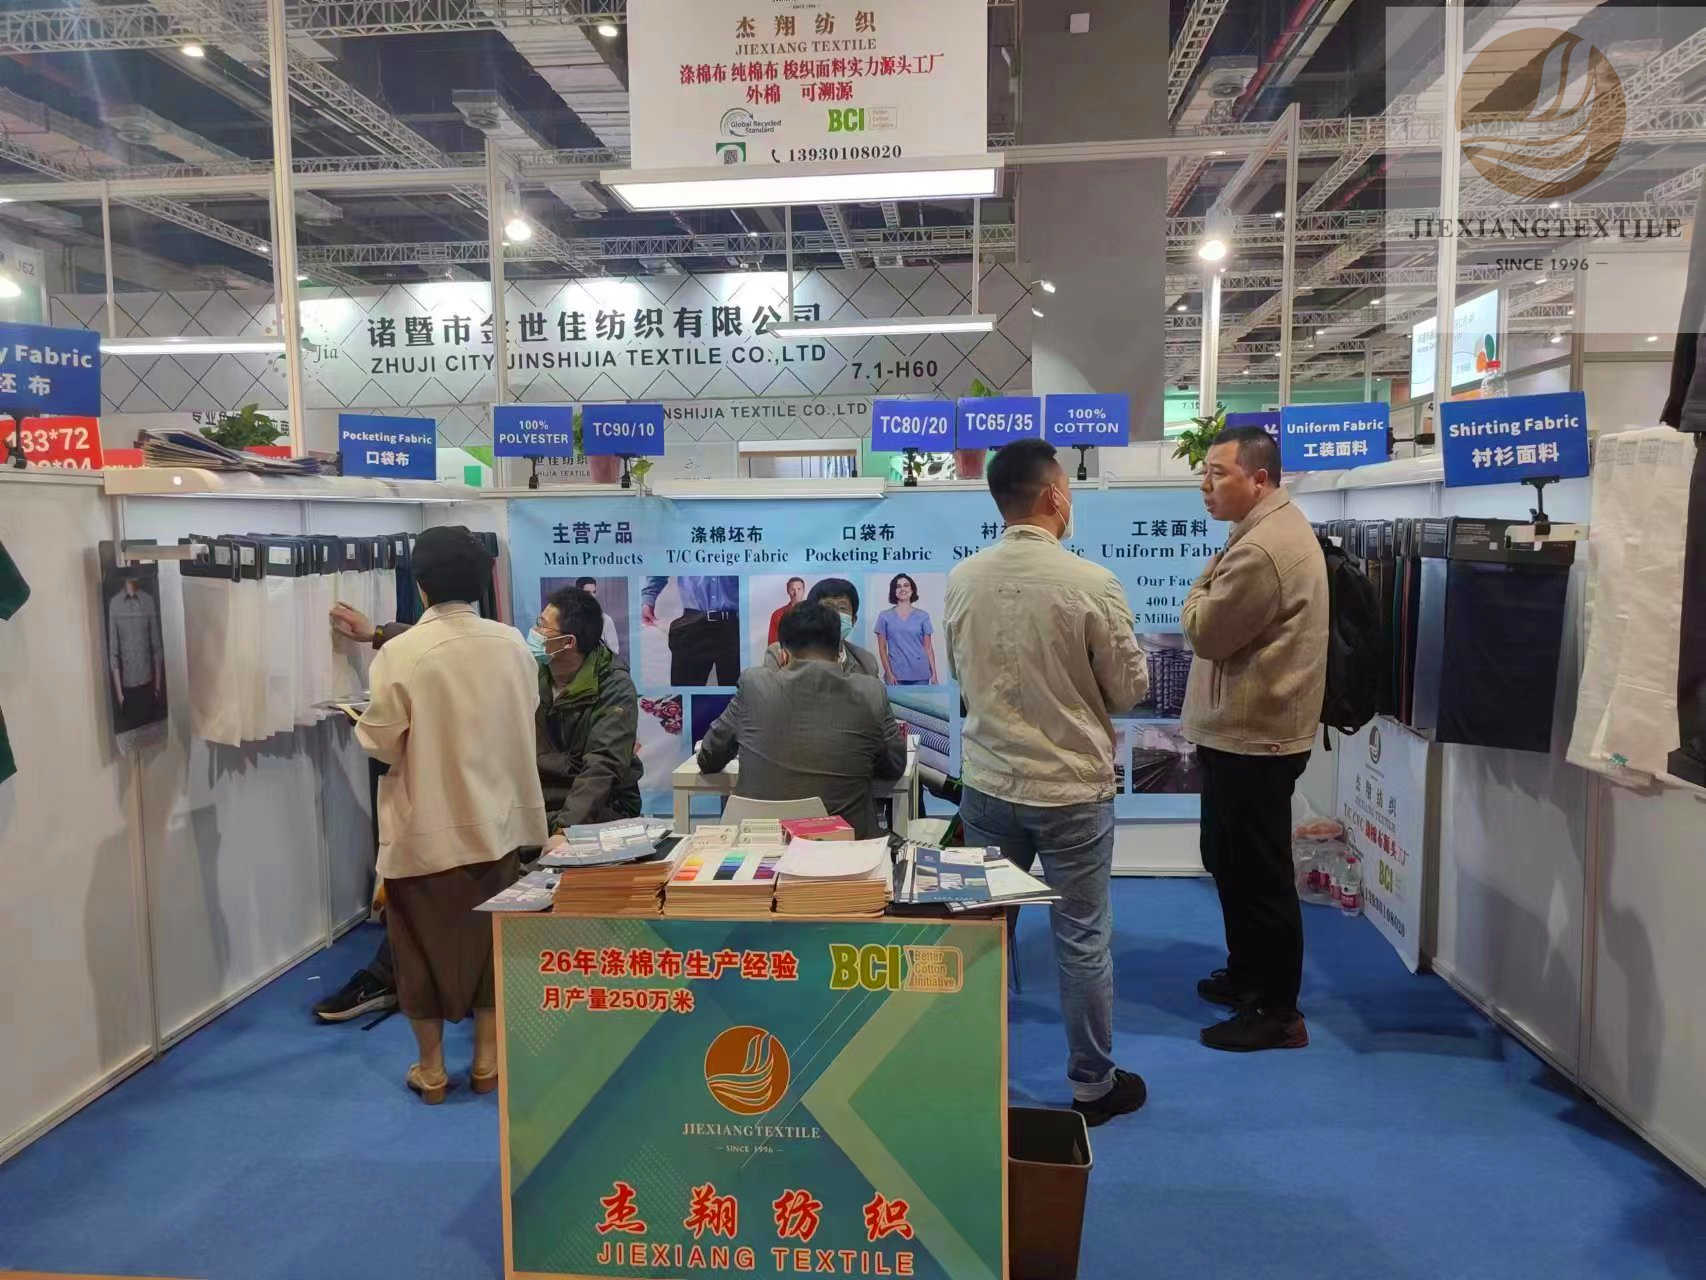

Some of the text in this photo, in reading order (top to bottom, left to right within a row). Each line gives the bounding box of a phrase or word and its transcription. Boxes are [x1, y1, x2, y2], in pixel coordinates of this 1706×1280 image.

[736, 10, 876, 39] 杰翔纺织
[736, 38, 877, 55] JIEXIANG TEXTILE
[680, 63, 727, 84] 涤棉布
[731, 60, 778, 81] 纯棉布
[731, 119, 782, 129] Global Recycled
[828, 108, 865, 133] BCI
[789, 145, 902, 162] 13930108020
[15, 344, 93, 369] Fabric
[371, 356, 436, 374] ZHUJI
[445, 353, 495, 372] CITY
[507, 350, 617, 370] JINSHIJIA
[626, 347, 721, 366] TEXTILE
[852, 360, 938, 380] 7.1-H60
[731, 403, 797, 419] TEXTILE
[1067, 408, 1107, 420] 100%
[519, 420, 549, 431] 100%
[593, 421, 655, 438] TC90/10
[880, 415, 948, 435] TC80/20
[965, 412, 1034, 433] TC65/35
[1053, 421, 1119, 434] COTTON
[1286, 420, 1341, 434] Uniform
[1343, 418, 1385, 432] Fabric
[1449, 414, 1580, 438] Shirting Fabric
[343, 430, 433, 446] Pocketing Fabric
[499, 433, 569, 445] POLYESTER
[1304, 440, 1368, 458] 工装面料
[1472, 443, 1560, 468] 衬衫面料
[366, 451, 410, 467] 口袋布
[552, 521, 634, 545] 主营产品
[690, 525, 763, 544] 涤棉坯布
[842, 524, 896, 541] 口袋布
[1131, 519, 1208, 537] 工装面料
[543, 551, 644, 566] Main Products
[666, 548, 789, 567] T/C Greige Fabric
[805, 546, 932, 566] Pocketing Fabric
[1102, 544, 1175, 558] Uniform
[1137, 575, 1165, 587] Our
[1146, 597, 1168, 607] 400
[1379, 859, 1393, 893] BCI
[538, 948, 799, 981] 26年涤棉布生产经验
[914, 950, 945, 963] Better
[829, 943, 901, 991] BCI
[914, 962, 947, 974] Cotton
[913, 976, 957, 989] Initiative
[541, 987, 696, 1014] 月产量250万米
[726, 1144, 750, 1153] SINCE
[595, 1180, 916, 1242] 杰翔纺织
[596, 1242, 915, 1277] JIEXIANG TEXTILE
